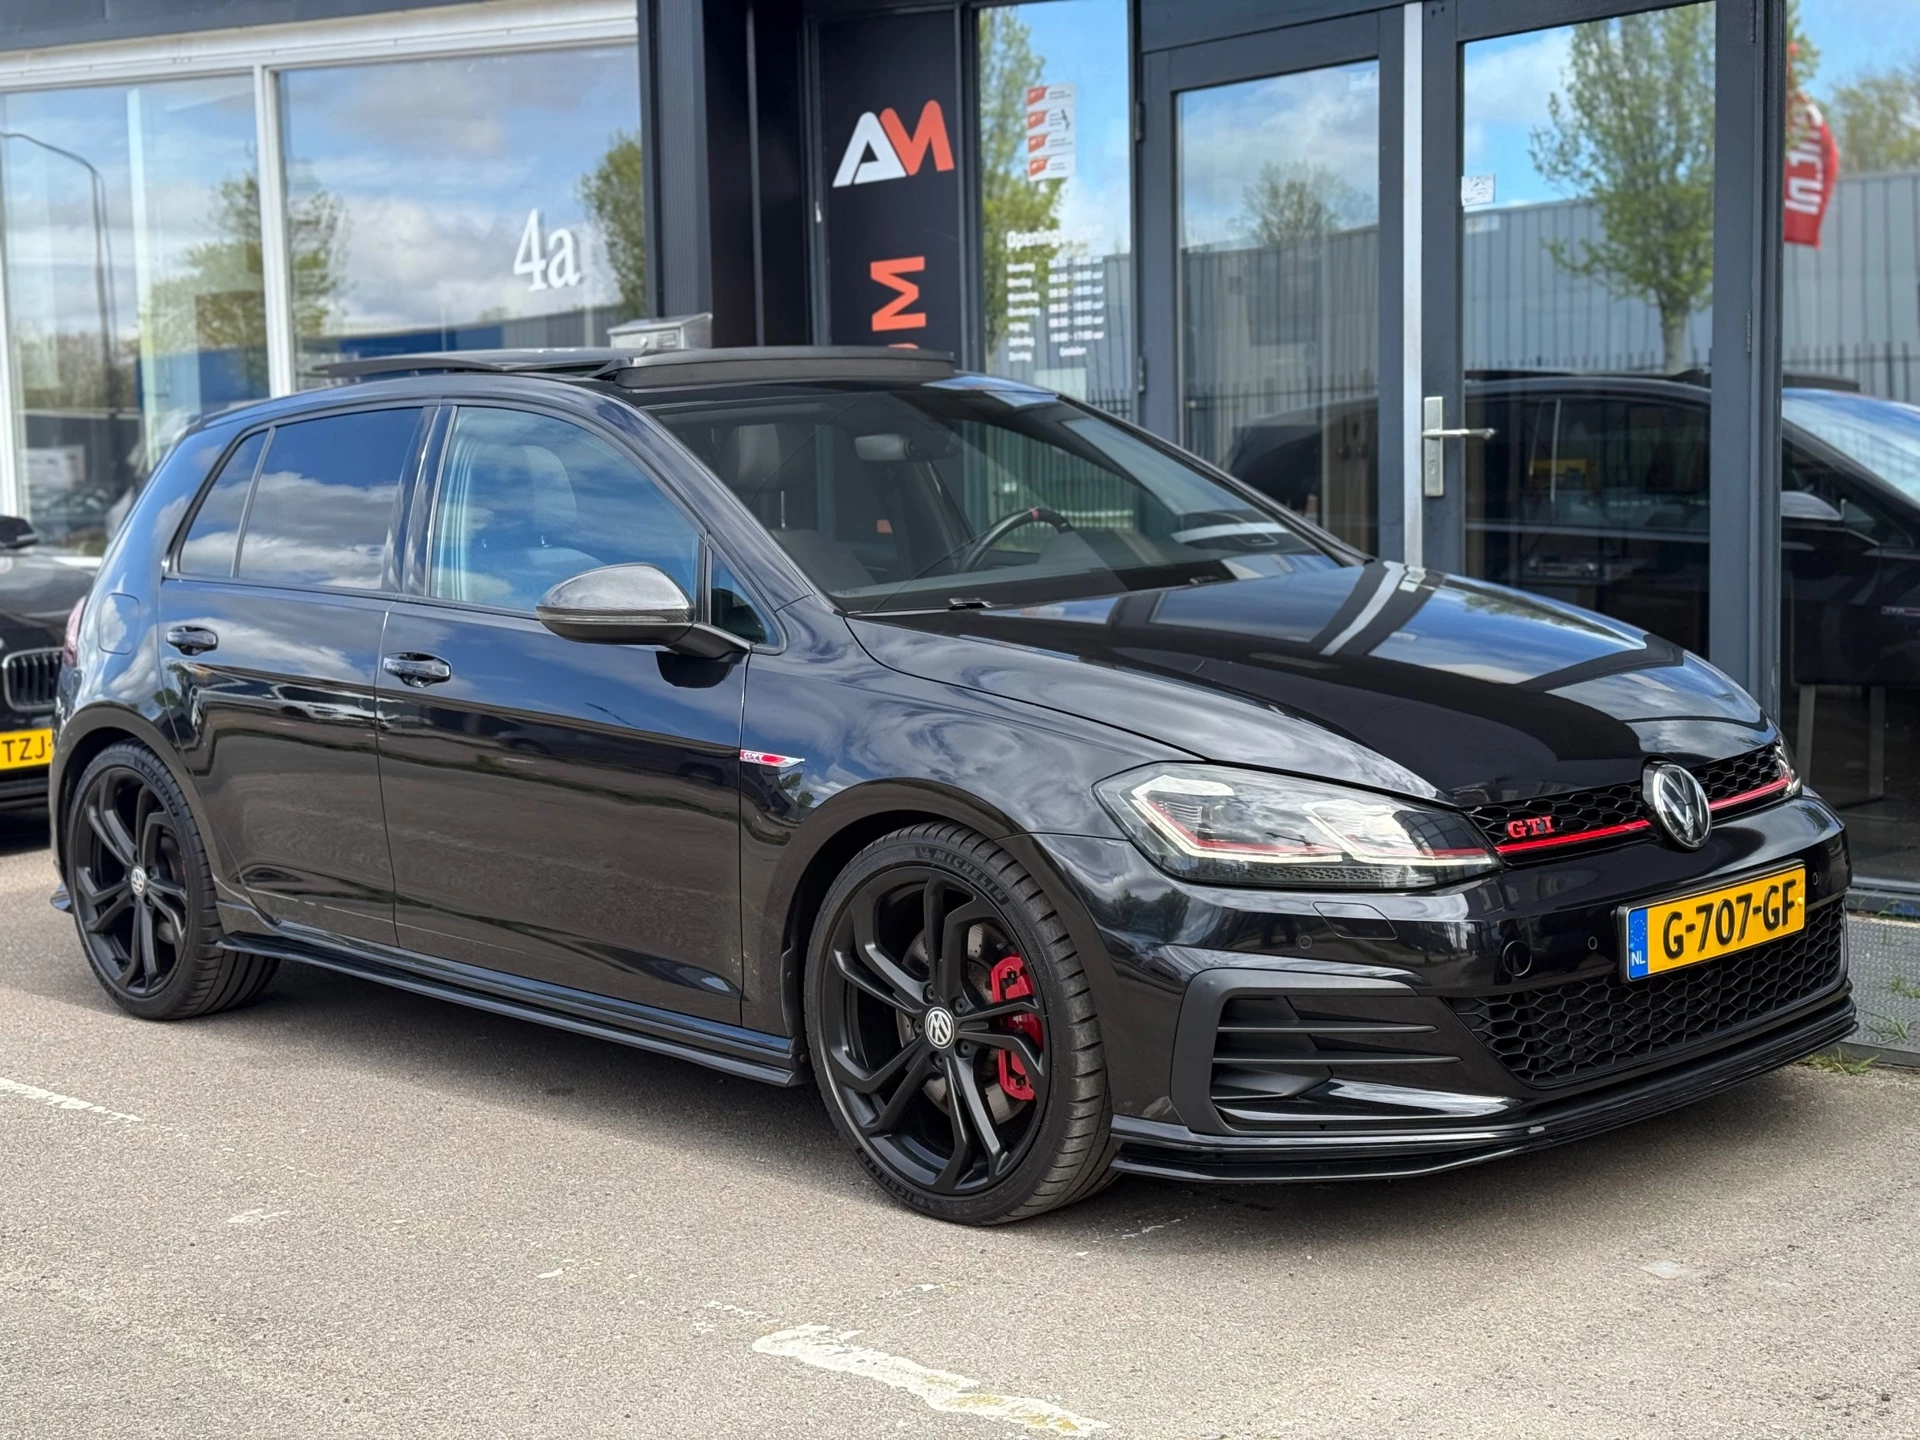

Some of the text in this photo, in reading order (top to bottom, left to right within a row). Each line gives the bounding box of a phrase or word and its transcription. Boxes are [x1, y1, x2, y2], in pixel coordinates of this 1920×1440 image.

[513, 206, 581, 292] 4a
[1507, 815, 1555, 838] GTI
[933, 848, 1006, 903] MICHELIN
[1631, 878, 1797, 967] NL G-707-GF
